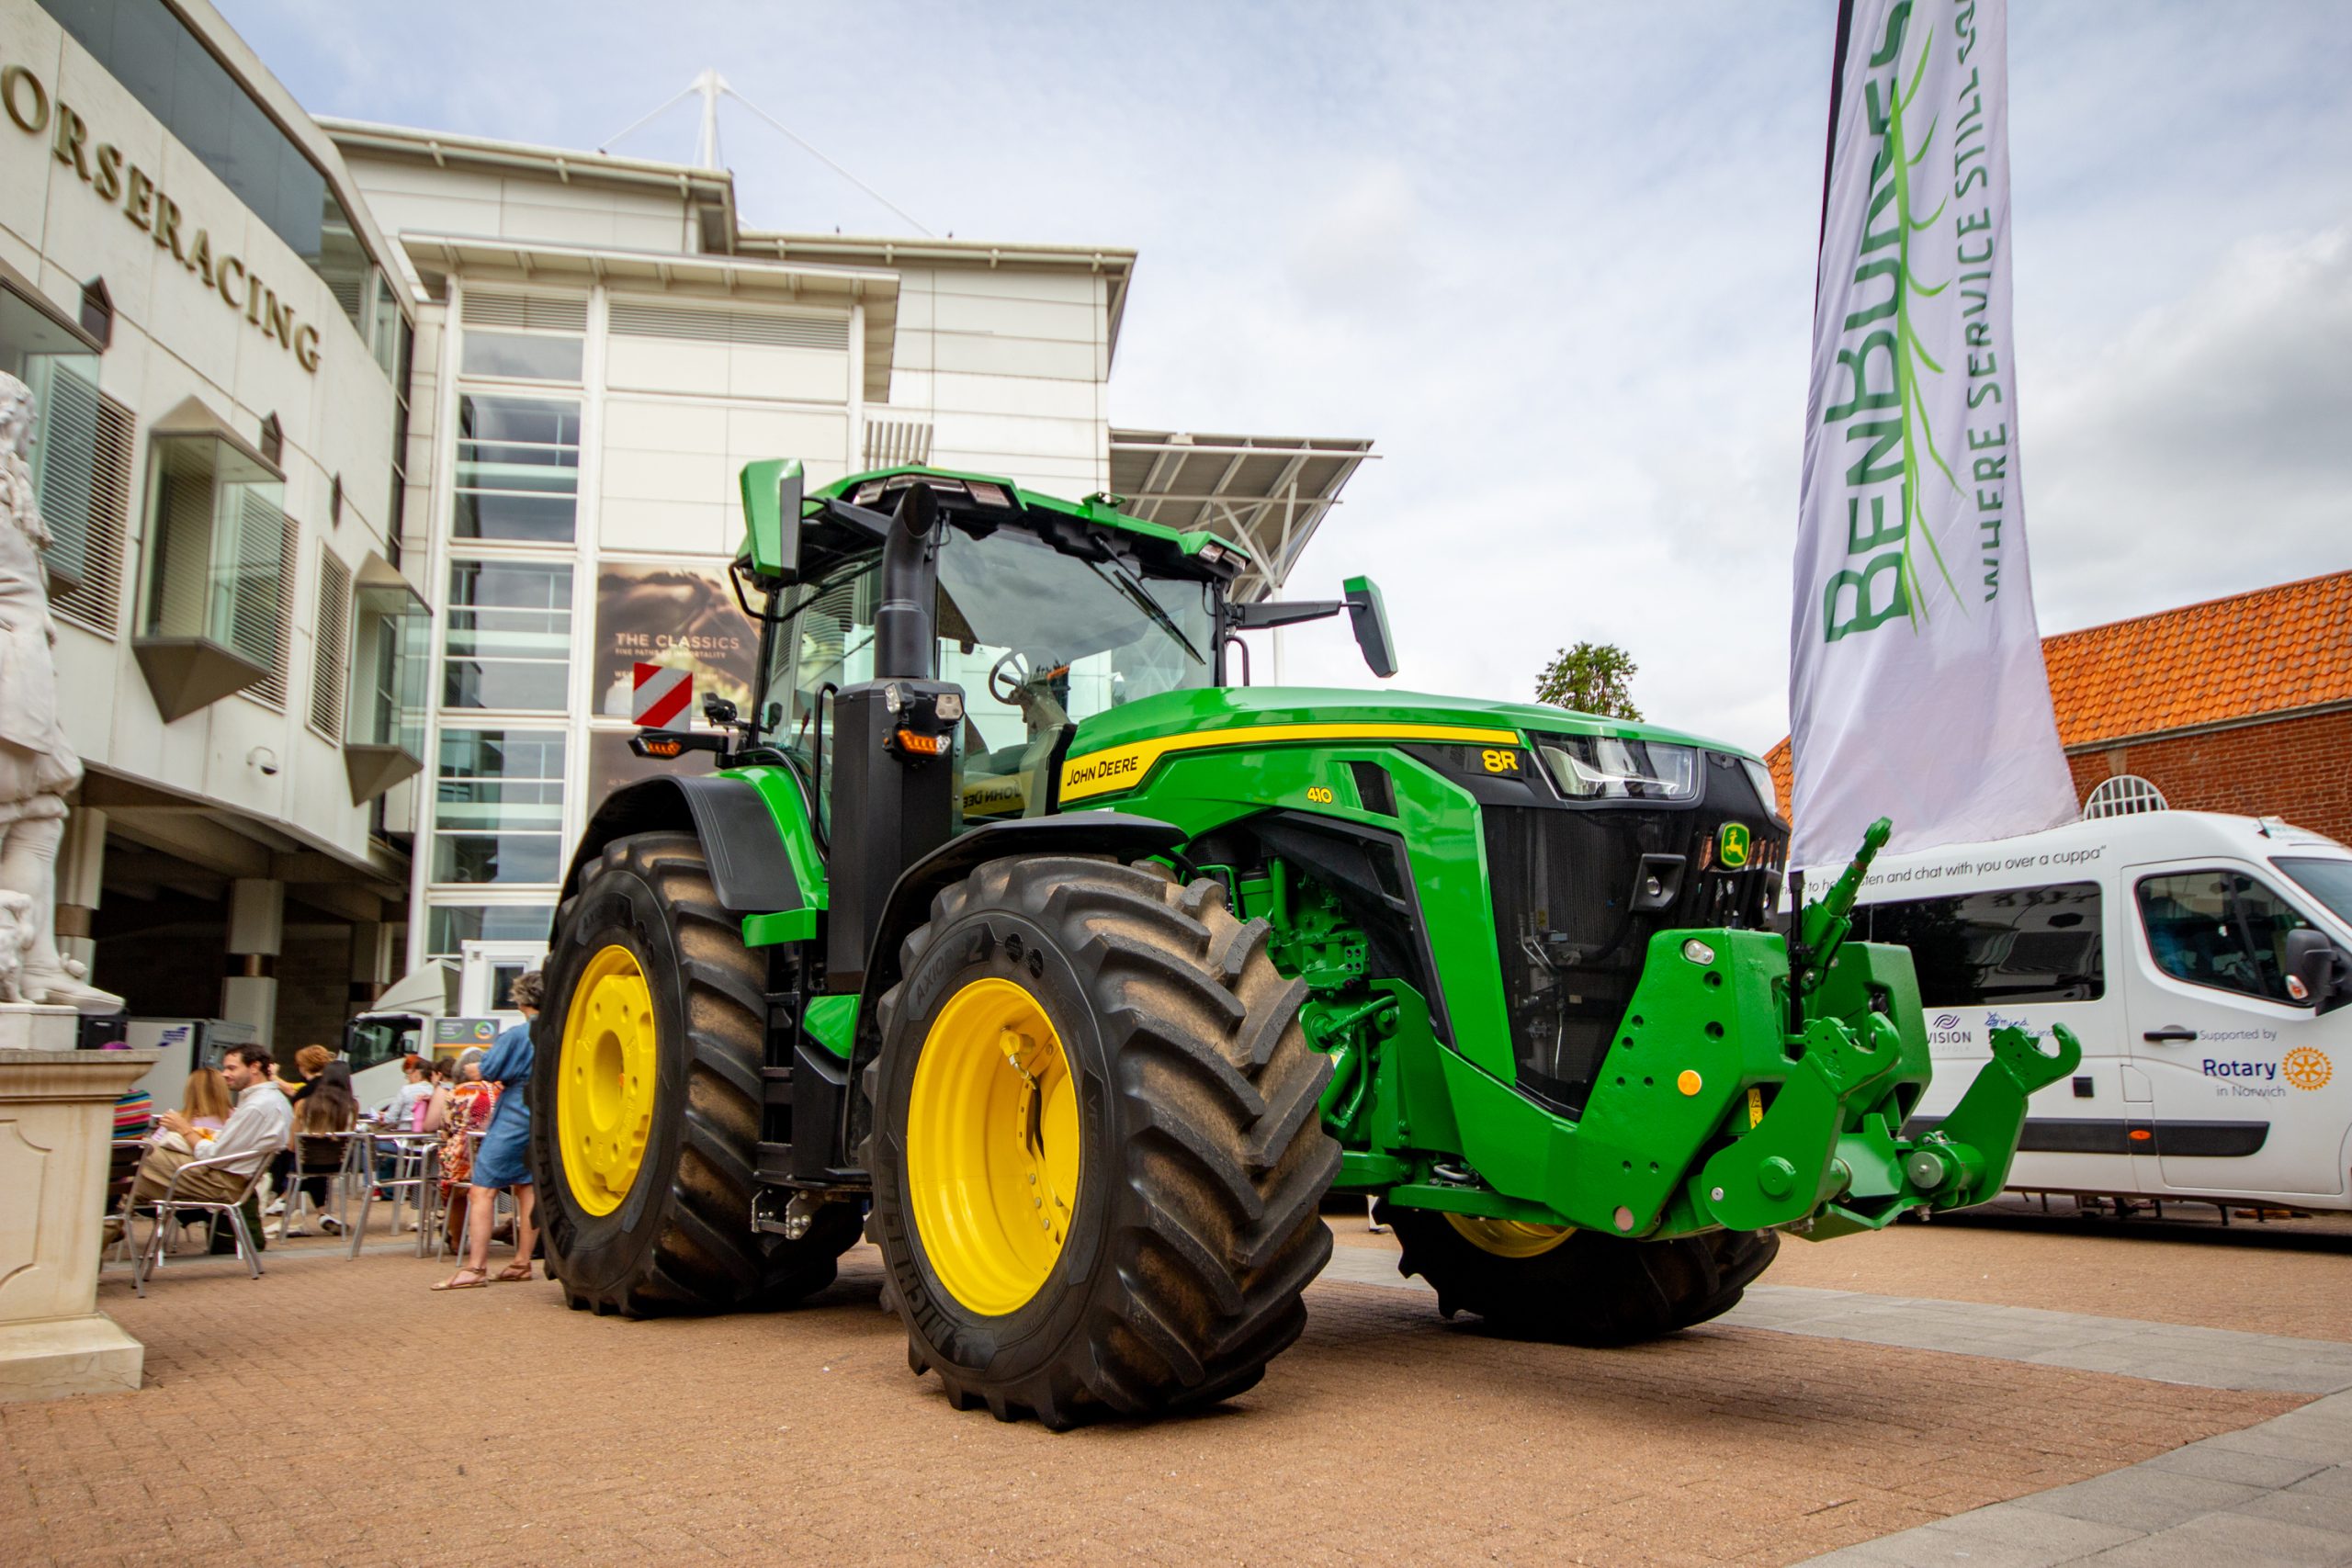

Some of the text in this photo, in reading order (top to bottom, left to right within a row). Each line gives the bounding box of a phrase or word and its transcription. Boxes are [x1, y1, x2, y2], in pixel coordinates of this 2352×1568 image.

[1954, 66, 1988, 198] STILL
[1, 63, 322, 373] ORSERACING
[1957, 207, 2003, 410] SERVICE
[1967, 423, 2007, 604] WHERE
[616, 632, 741, 649] THE CLASSICS
[1067, 756, 1138, 786] JOHN DEERE
[1481, 749, 1519, 773] 8R
[1306, 787, 1333, 805] 410
[1808, 881, 1820, 893] to
[1887, 867, 1913, 884] and
[1915, 865, 1942, 880] chat
[1945, 861, 1973, 877] with
[1976, 860, 2001, 875] you
[2005, 854, 2036, 870] over
[2039, 853, 2049, 865] a
[2199, 1029, 2278, 1042] Supported by
[2202, 1058, 2277, 1080] Rotary
[2216, 1085, 2286, 1098] in Norwich
